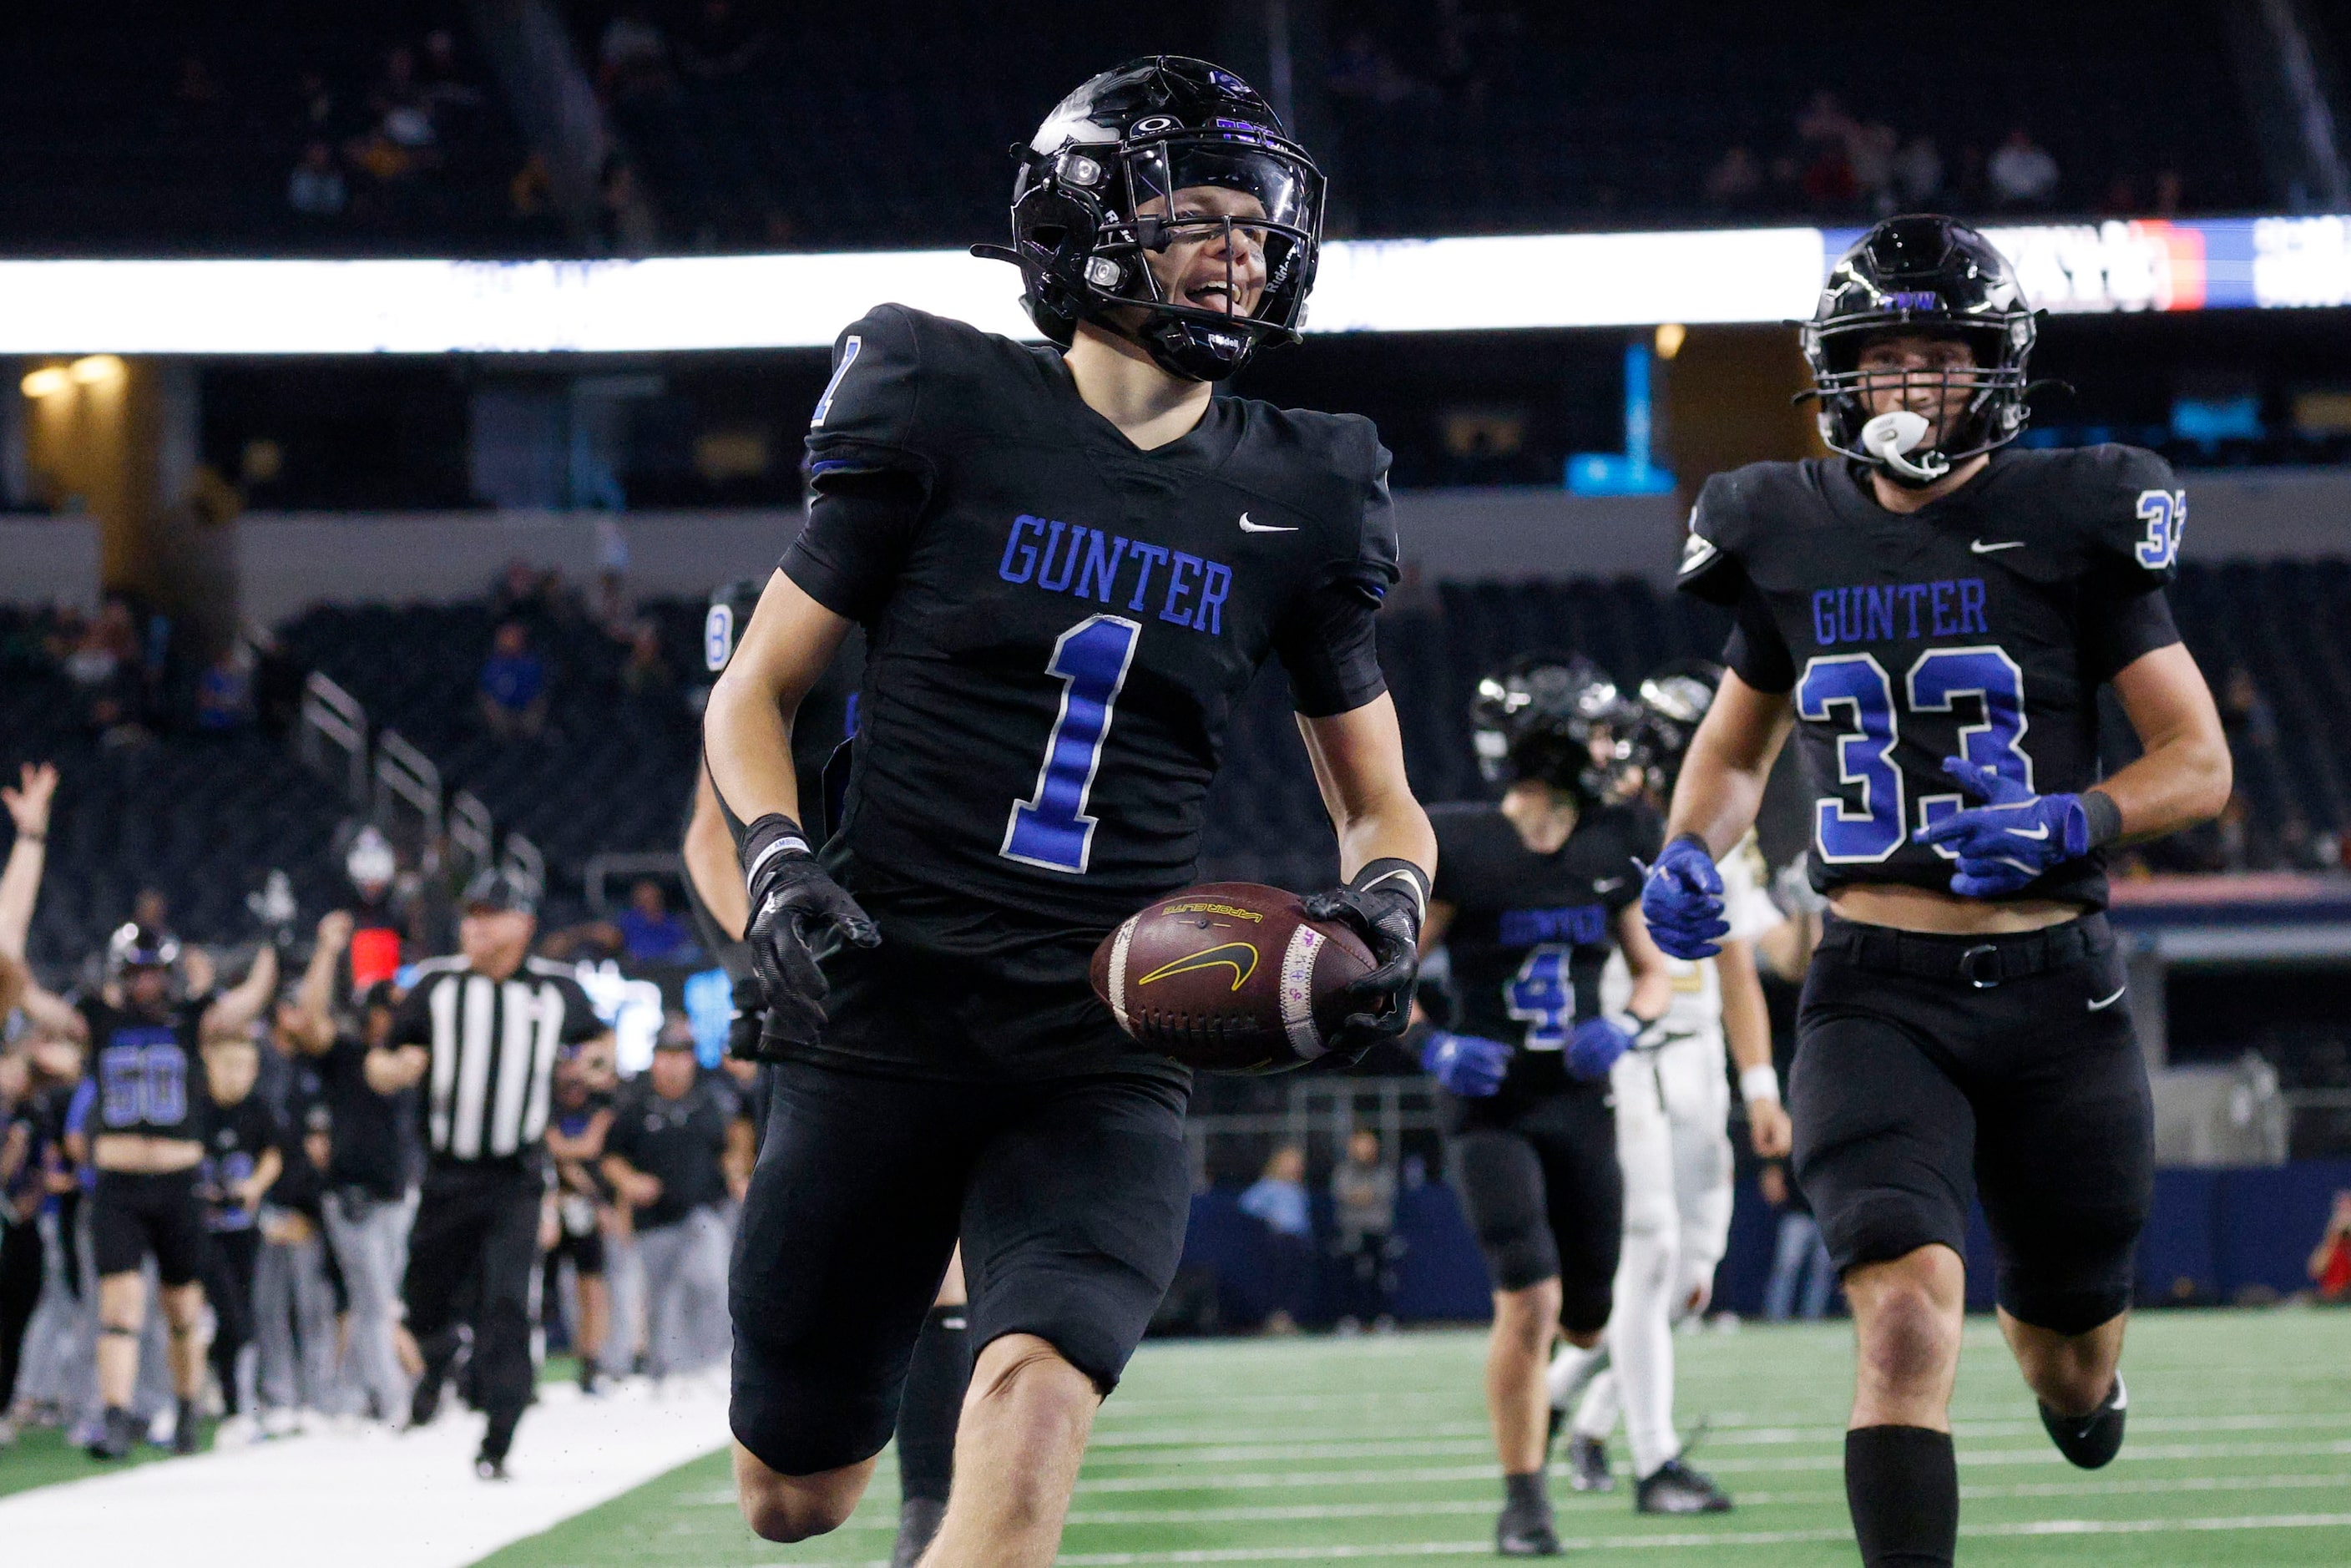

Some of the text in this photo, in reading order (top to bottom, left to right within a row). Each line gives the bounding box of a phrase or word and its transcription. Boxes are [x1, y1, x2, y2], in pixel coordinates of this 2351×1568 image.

[811, 336, 862, 427] 1
[999, 514, 1233, 635] GUNTER
[1812, 578, 1988, 645] GUNTER
[999, 613, 1142, 874] 1
[1796, 645, 2035, 863] 33
[1504, 943, 1575, 1050] 4
[99, 1044, 188, 1126] 50
